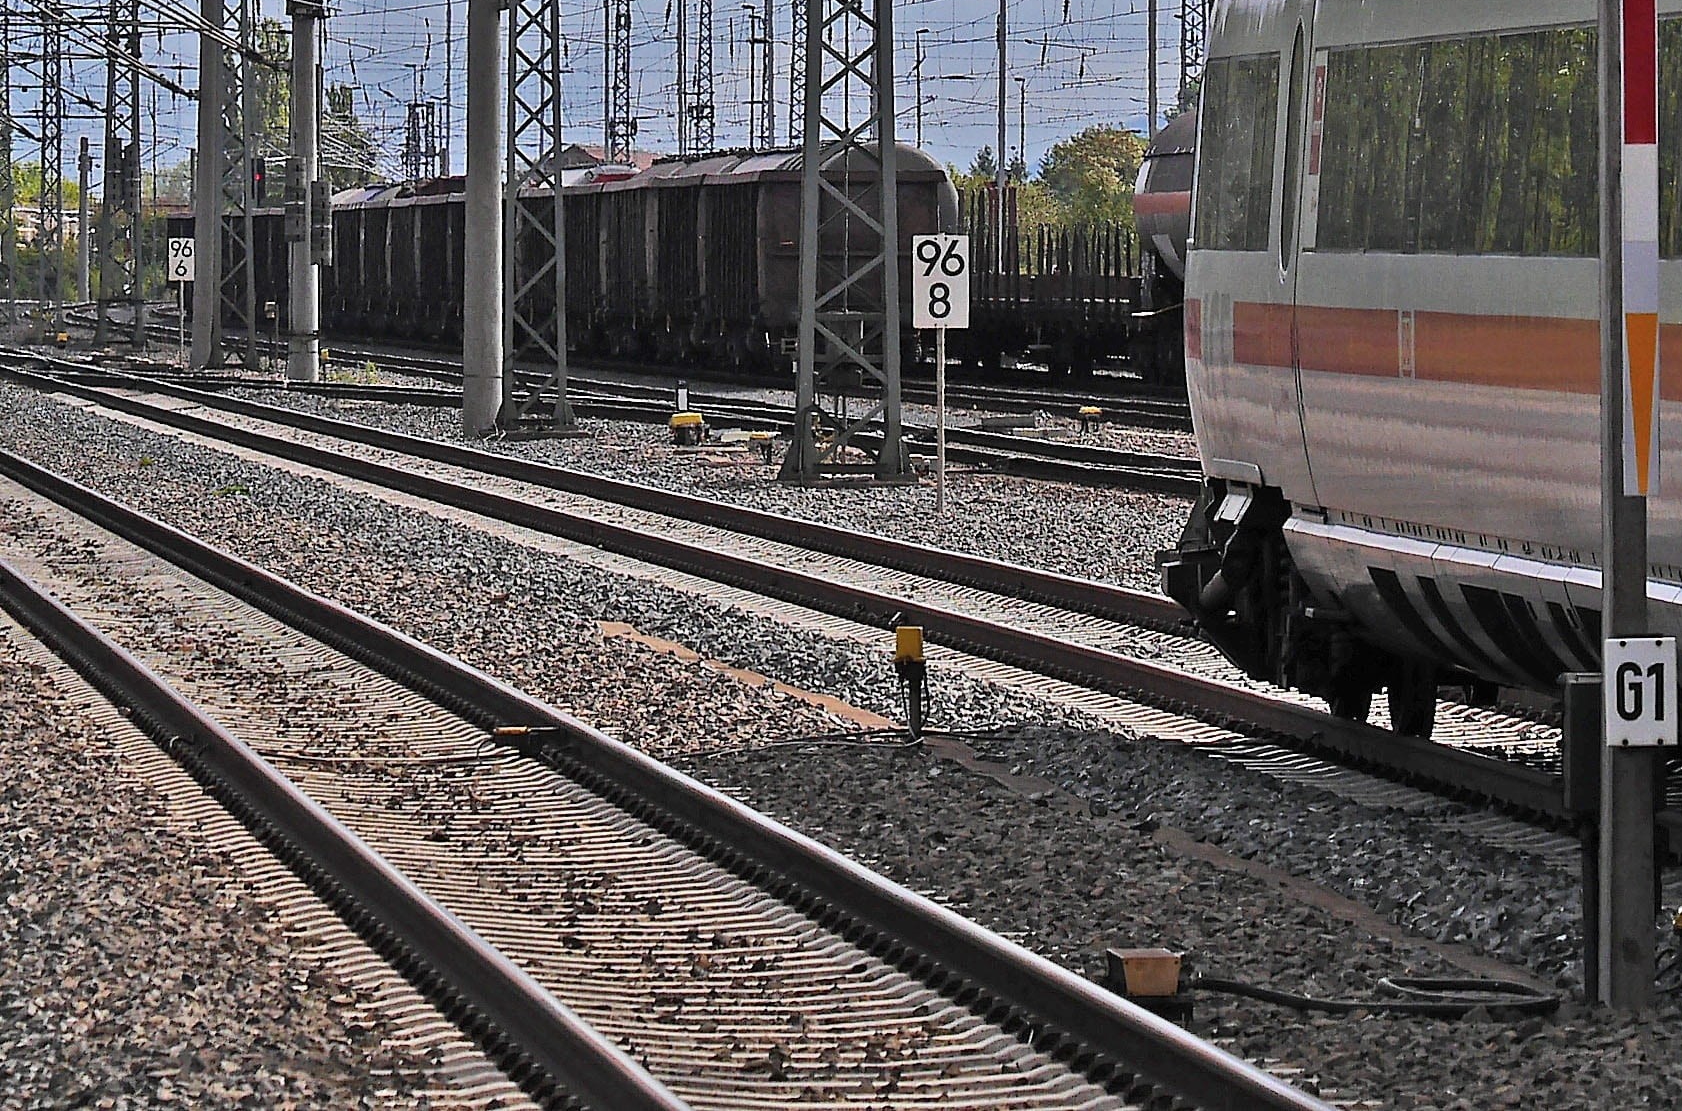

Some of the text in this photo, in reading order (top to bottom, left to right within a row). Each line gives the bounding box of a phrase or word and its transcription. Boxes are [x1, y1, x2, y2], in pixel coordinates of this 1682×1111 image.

[171, 240, 193, 257] 96
[916, 240, 965, 276] 96
[175, 259, 188, 277] 6
[928, 282, 951, 318] 8
[1616, 661, 1665, 721] G1
